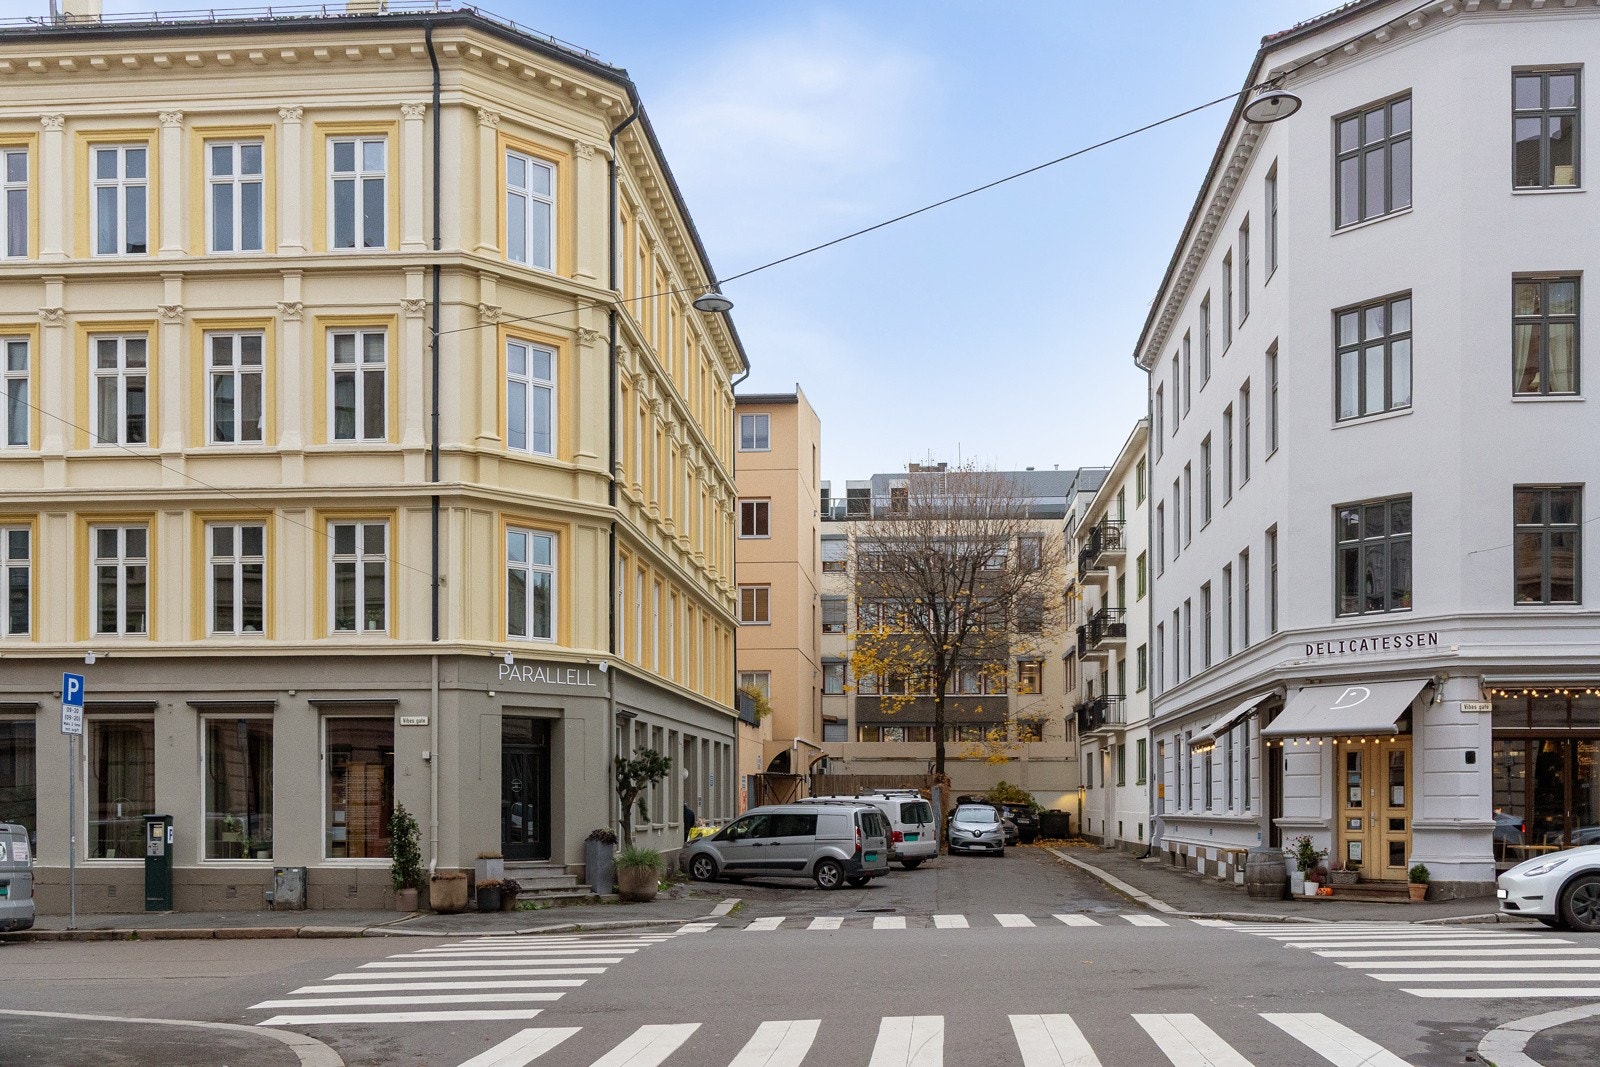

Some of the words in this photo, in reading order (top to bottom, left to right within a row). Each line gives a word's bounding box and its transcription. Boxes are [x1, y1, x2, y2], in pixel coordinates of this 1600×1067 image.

[1306, 632, 1438, 656] DELICATESSEN
[499, 663, 597, 687] PARALLELL
[67, 677, 80, 701] P
